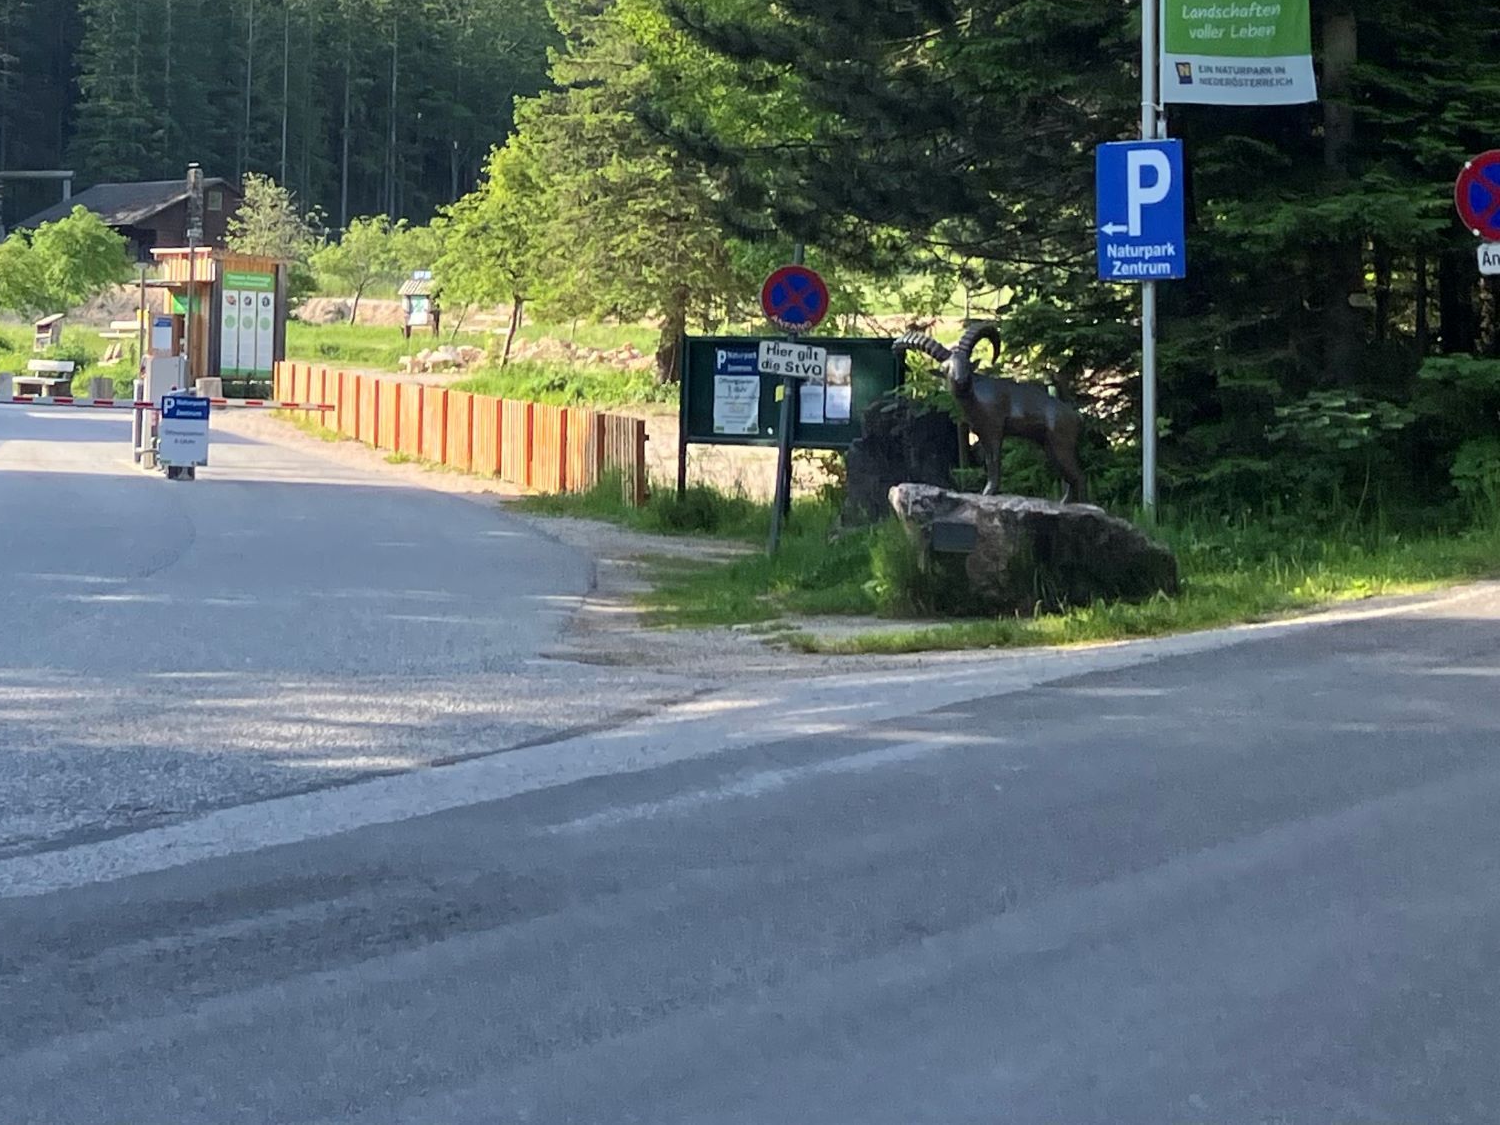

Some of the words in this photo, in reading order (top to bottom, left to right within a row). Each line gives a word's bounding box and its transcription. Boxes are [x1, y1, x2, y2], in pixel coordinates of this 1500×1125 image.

[1181, 1, 1282, 20] Landschaften
[1188, 23, 1226, 39] voller
[1230, 23, 1276, 39] Leben
[1198, 64, 1213, 74] EIN
[1215, 65, 1272, 75] NATURPARK
[1274, 65, 1286, 74] IN
[1199, 76, 1293, 88] NIEDERÖSTERREICH
[1127, 149, 1171, 236] P
[1107, 242, 1176, 259] Naturpark
[1112, 260, 1171, 275] Zentrum
[766, 342, 793, 357] Hier
[798, 346, 819, 362] gilt
[761, 358, 781, 371] die
[785, 361, 823, 376] StVO
